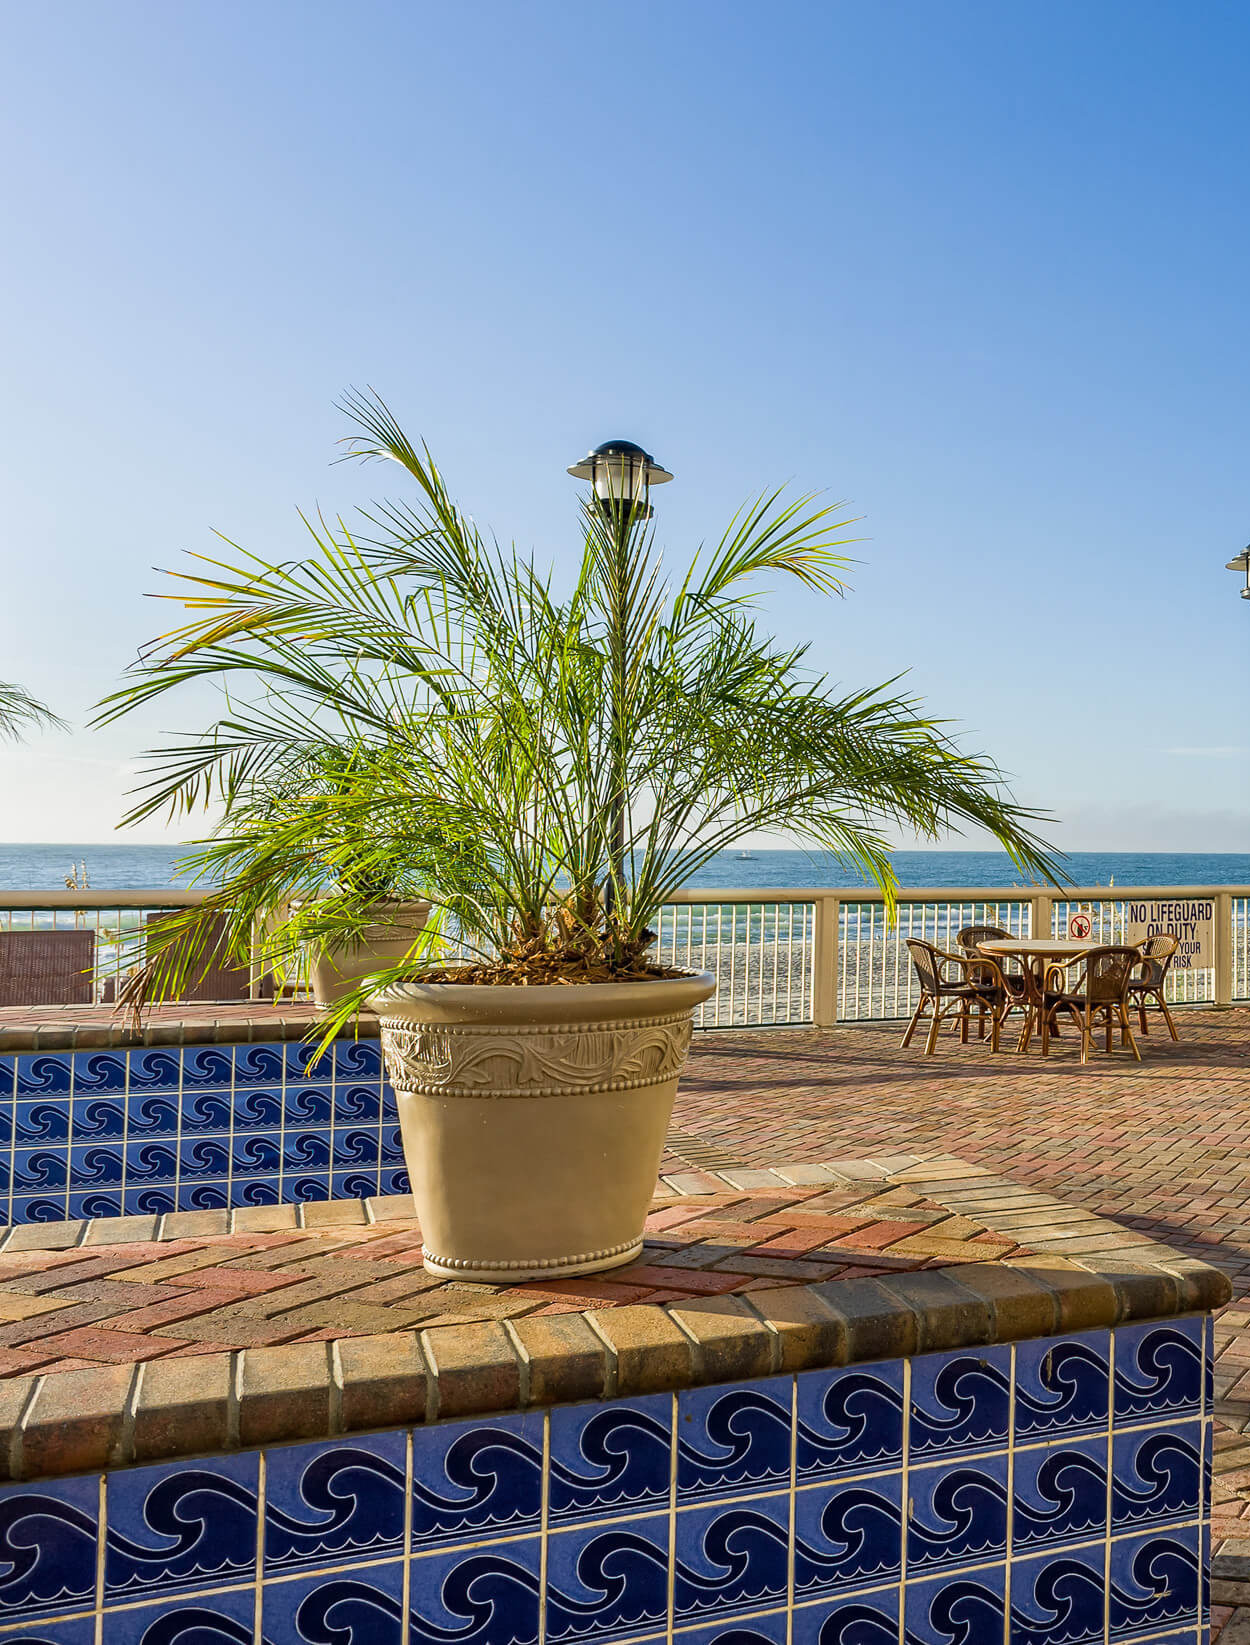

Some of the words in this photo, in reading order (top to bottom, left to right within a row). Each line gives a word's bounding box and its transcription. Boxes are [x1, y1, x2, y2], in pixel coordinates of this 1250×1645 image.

[1130, 904, 1147, 923] NO
[1151, 903, 1212, 922] LIFEGUARD
[1147, 923, 1163, 938] ON
[1167, 922, 1196, 940] DUTY
[1180, 942, 1201, 955] YOUR
[1173, 955, 1192, 968] RISK
